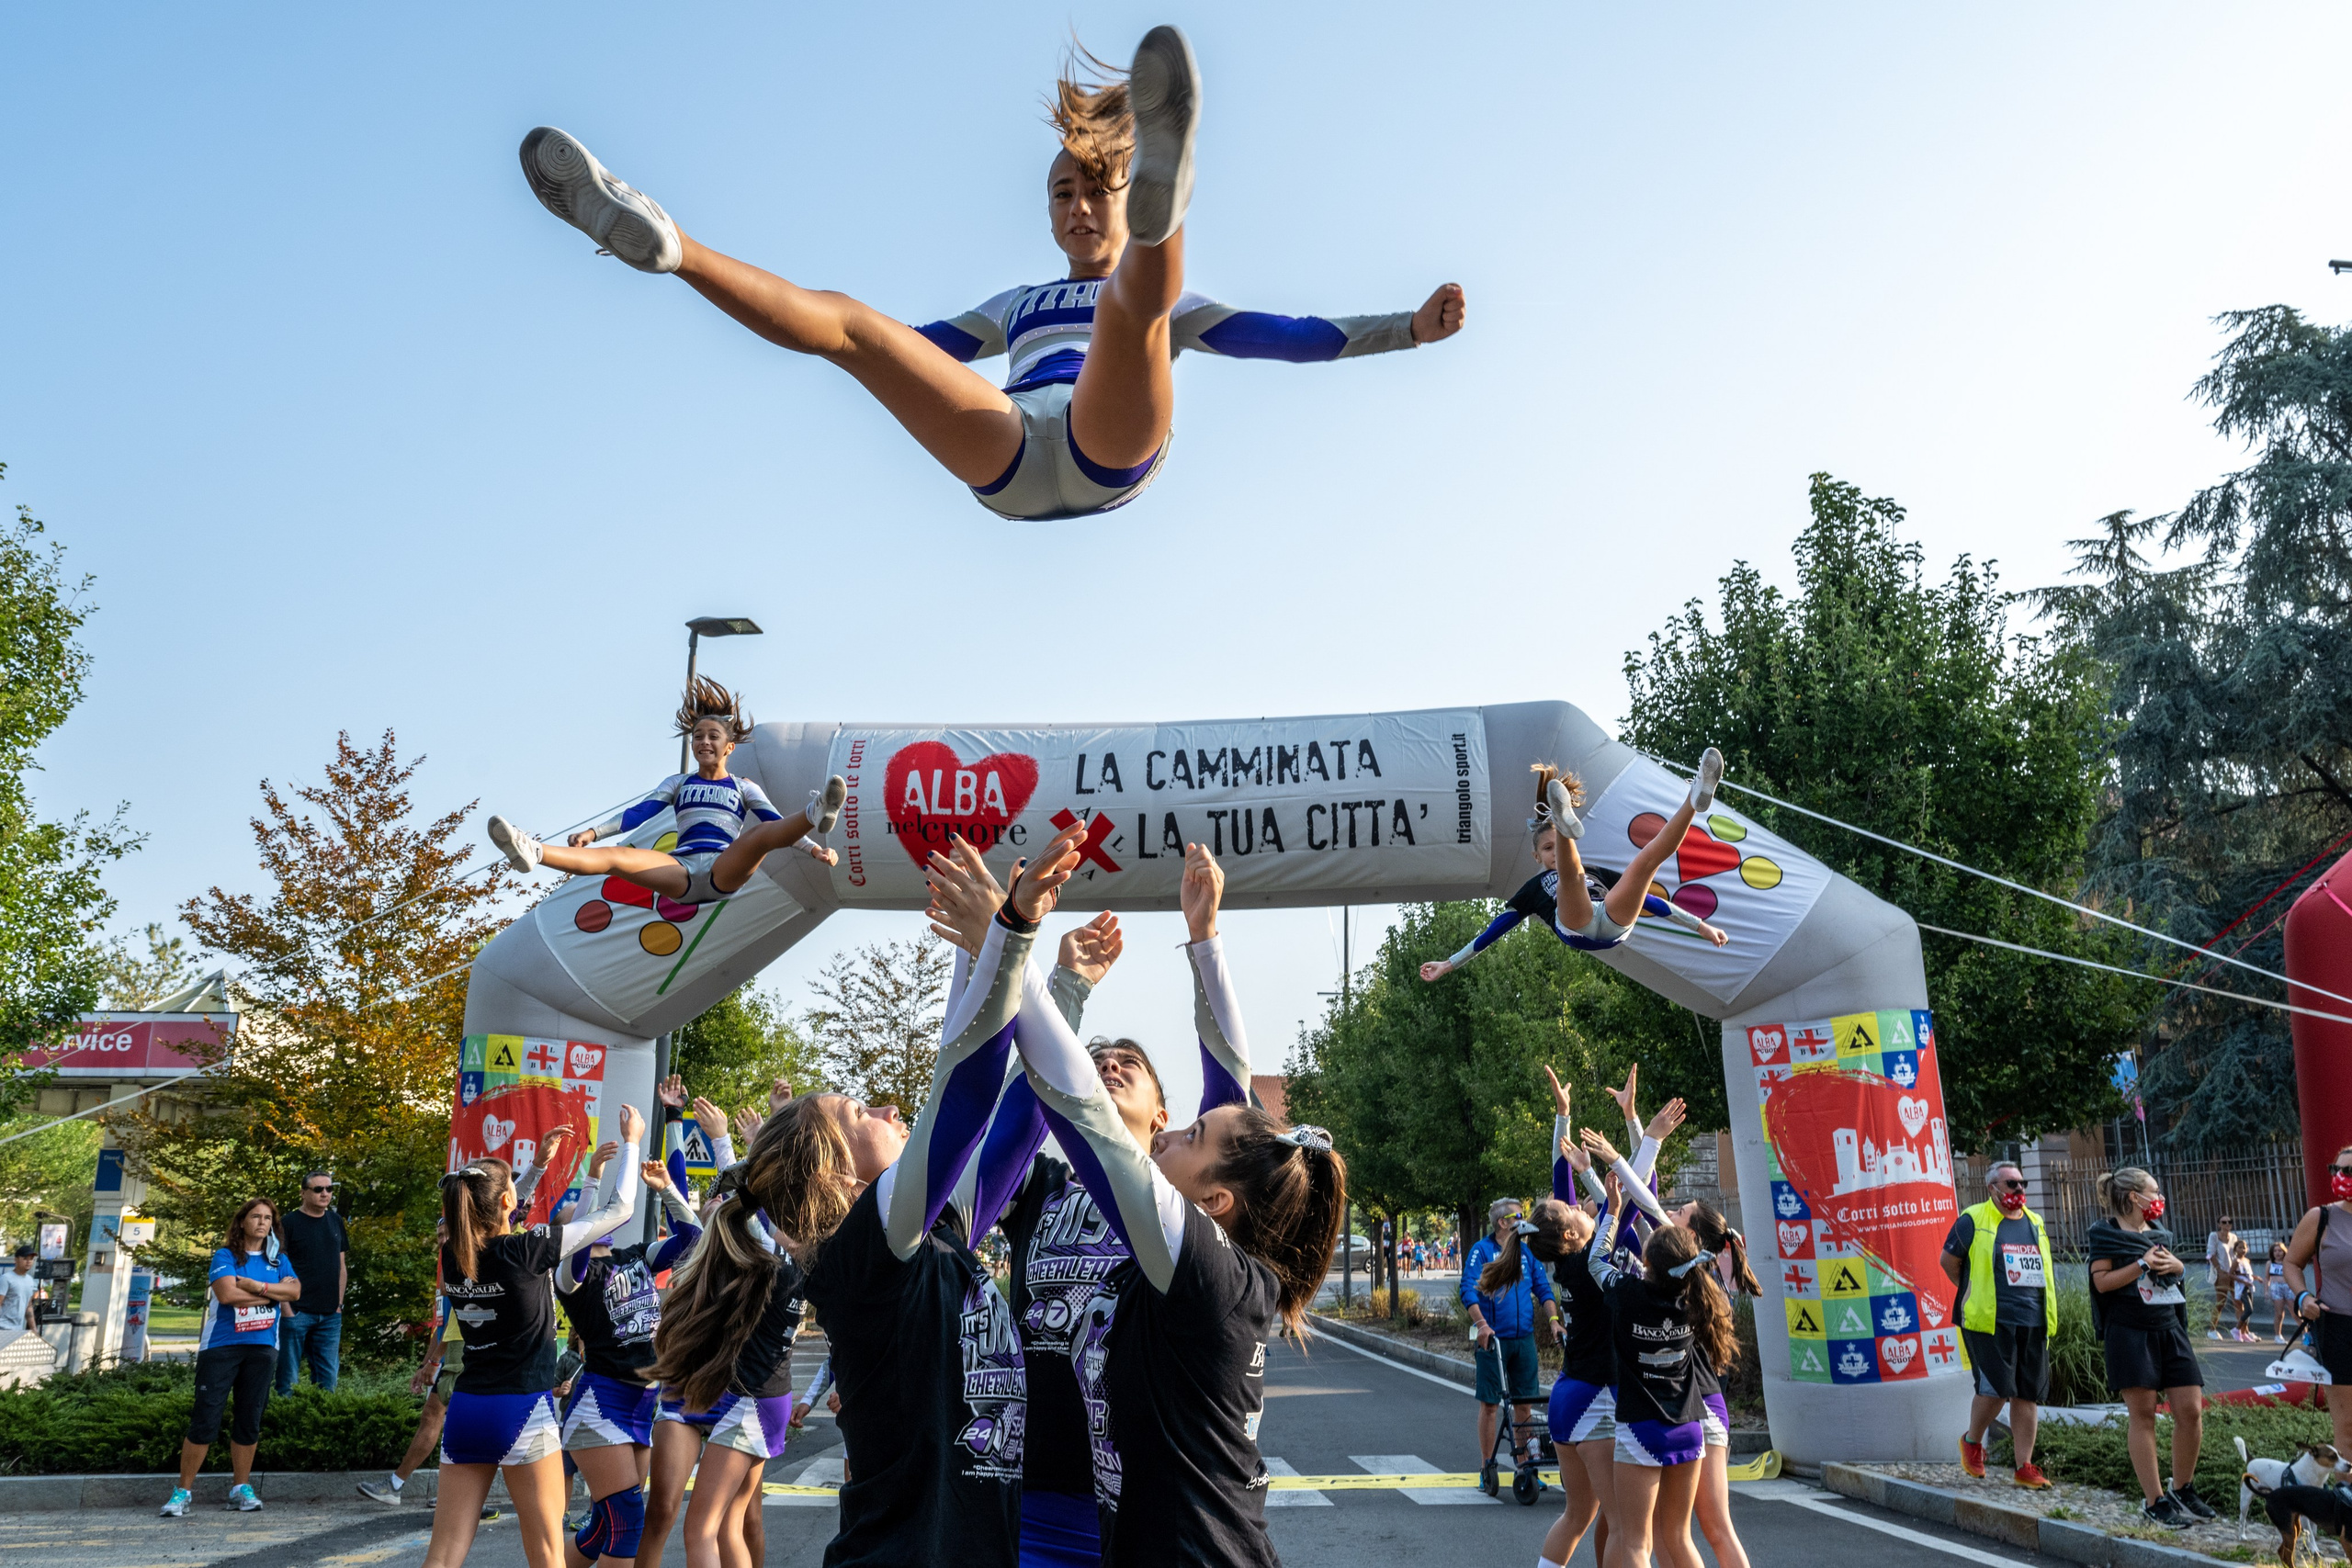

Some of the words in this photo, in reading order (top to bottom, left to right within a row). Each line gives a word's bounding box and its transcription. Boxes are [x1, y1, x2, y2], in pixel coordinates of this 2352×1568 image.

[1009, 280, 1105, 333] TITA
[846, 739, 866, 769] torri
[1452, 733, 1470, 777] sport.it
[1076, 752, 1123, 795] LA
[1146, 739, 1382, 791] CAMMINATA
[846, 774, 859, 788] le
[901, 769, 1008, 817] ALBA
[679, 784, 741, 812] TITANS
[843, 795, 859, 839] sotto
[1456, 780, 1473, 844] triangolo
[1138, 812, 1186, 859] LA
[1206, 807, 1285, 856] TUA
[1306, 799, 1428, 851] CITTA'
[843, 845, 866, 887] Corri
[27, 1027, 132, 1052] rvice
[1757, 1036, 1776, 1048] ALBA
[575, 1053, 594, 1064] ALBA
[1905, 1106, 1924, 1120] ALBA
[487, 1124, 507, 1138] ALBA
[1039, 1191, 1117, 1249] JUS
[1838, 1204, 1878, 1223] Corri
[1883, 1201, 1917, 1218] sotto
[1920, 1198, 1930, 1213] le
[1933, 1196, 1953, 1212] torri
[133, 1226, 141, 1236] 5
[1781, 1230, 1801, 1242] ALBA
[1857, 1217, 1946, 1234] WWW.TRIANGOLOSPORT.IT
[2018, 1244, 2039, 1254] IDEA
[1027, 1257, 1129, 1283] CHEERLEA
[2019, 1257, 2041, 1270] 1325
[965, 1309, 989, 1334] IT'S
[1025, 1309, 1044, 1320] 24
[1050, 1306, 1066, 1321] 7
[1633, 1323, 1666, 1337] BANCA
[1888, 1345, 1911, 1358] ALBA
[966, 1368, 1026, 1397] CHEERLEA
[963, 1427, 991, 1440] 24
